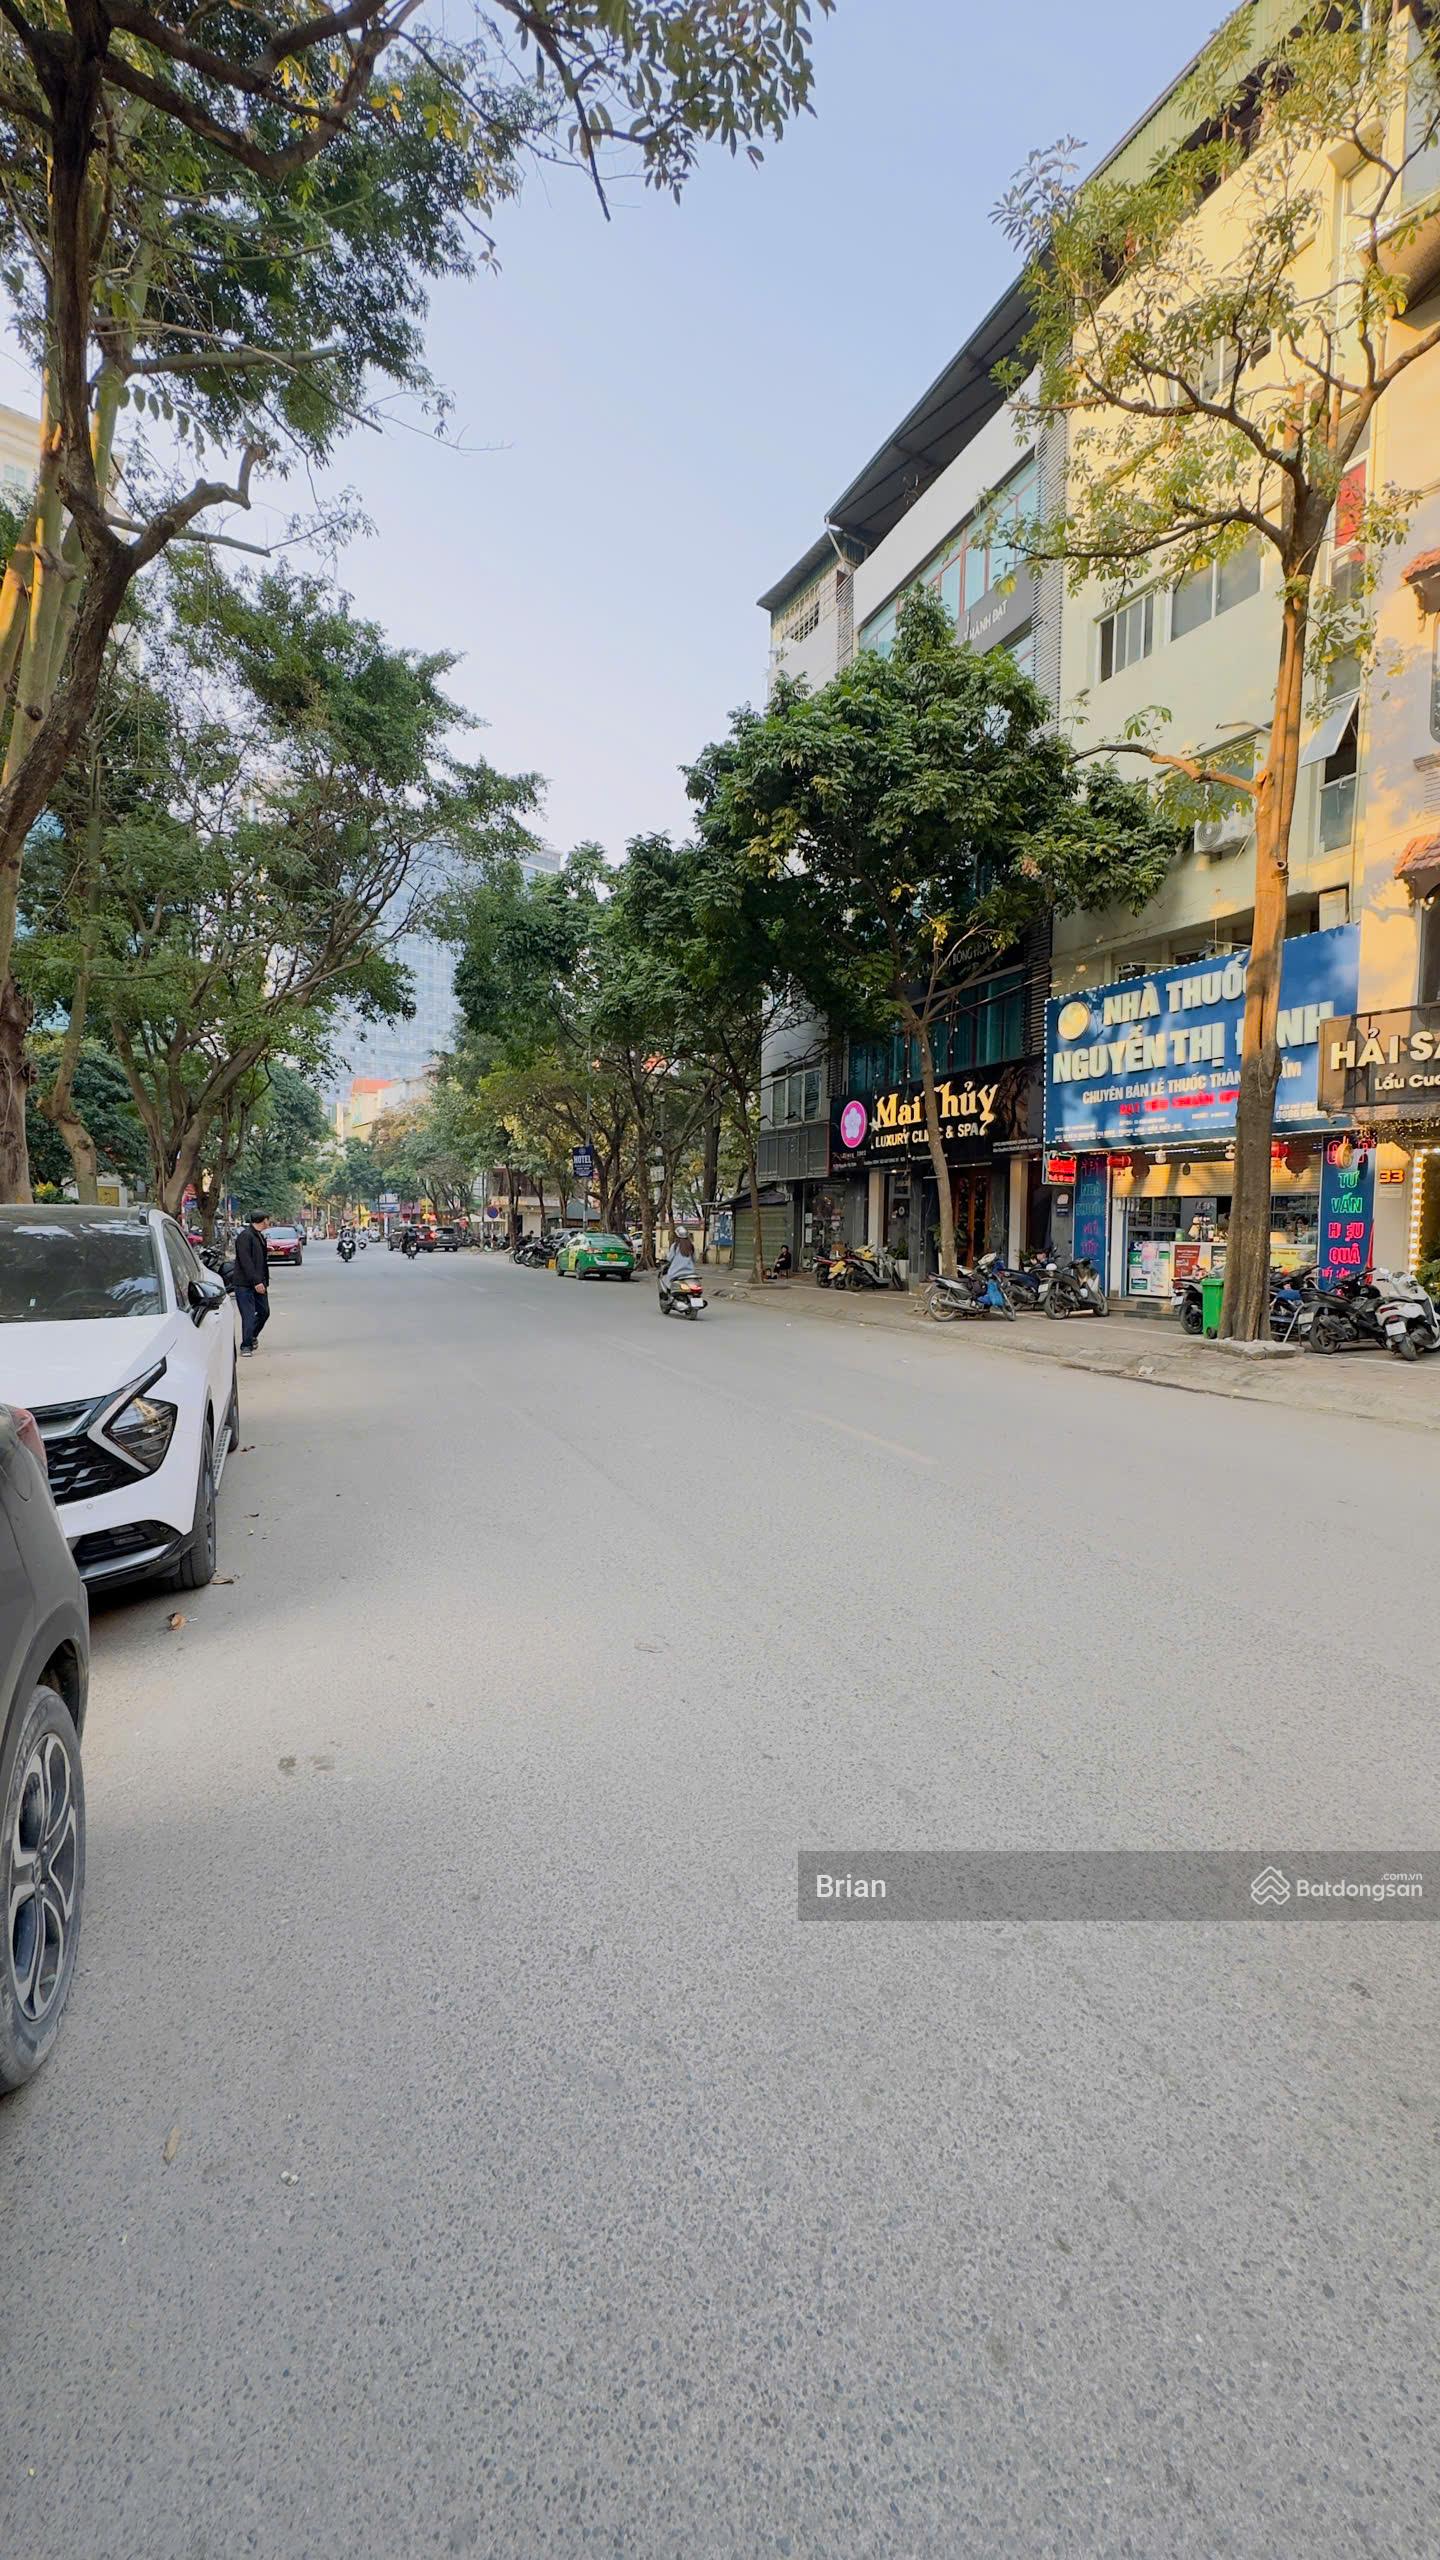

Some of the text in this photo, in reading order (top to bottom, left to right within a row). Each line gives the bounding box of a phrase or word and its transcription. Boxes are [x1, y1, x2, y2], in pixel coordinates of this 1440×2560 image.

[1103, 953, 1247, 1026] NHÀ THUỐ
[1053, 1024, 1167, 1083] NGUYỄN
[1170, 1022, 1225, 1068] THỊ
[1330, 1027, 1440, 1070] HẢI S
[1082, 1086, 1124, 1105] CHUYÊN
[1125, 1082, 1149, 1099] BÁN
[1168, 1072, 1207, 1094] THUỐC
[876, 1093, 922, 1127] Mai
[875, 1132, 910, 1148] LUXURY
[945, 1125, 954, 1138] &
[957, 1122, 980, 1138] SPA
[573, 1155, 592, 1164] HOTEL
[1339, 1170, 1360, 1188] TƯ
[1379, 1169, 1404, 1184] 33
[1331, 1192, 1362, 1213] VẤN
